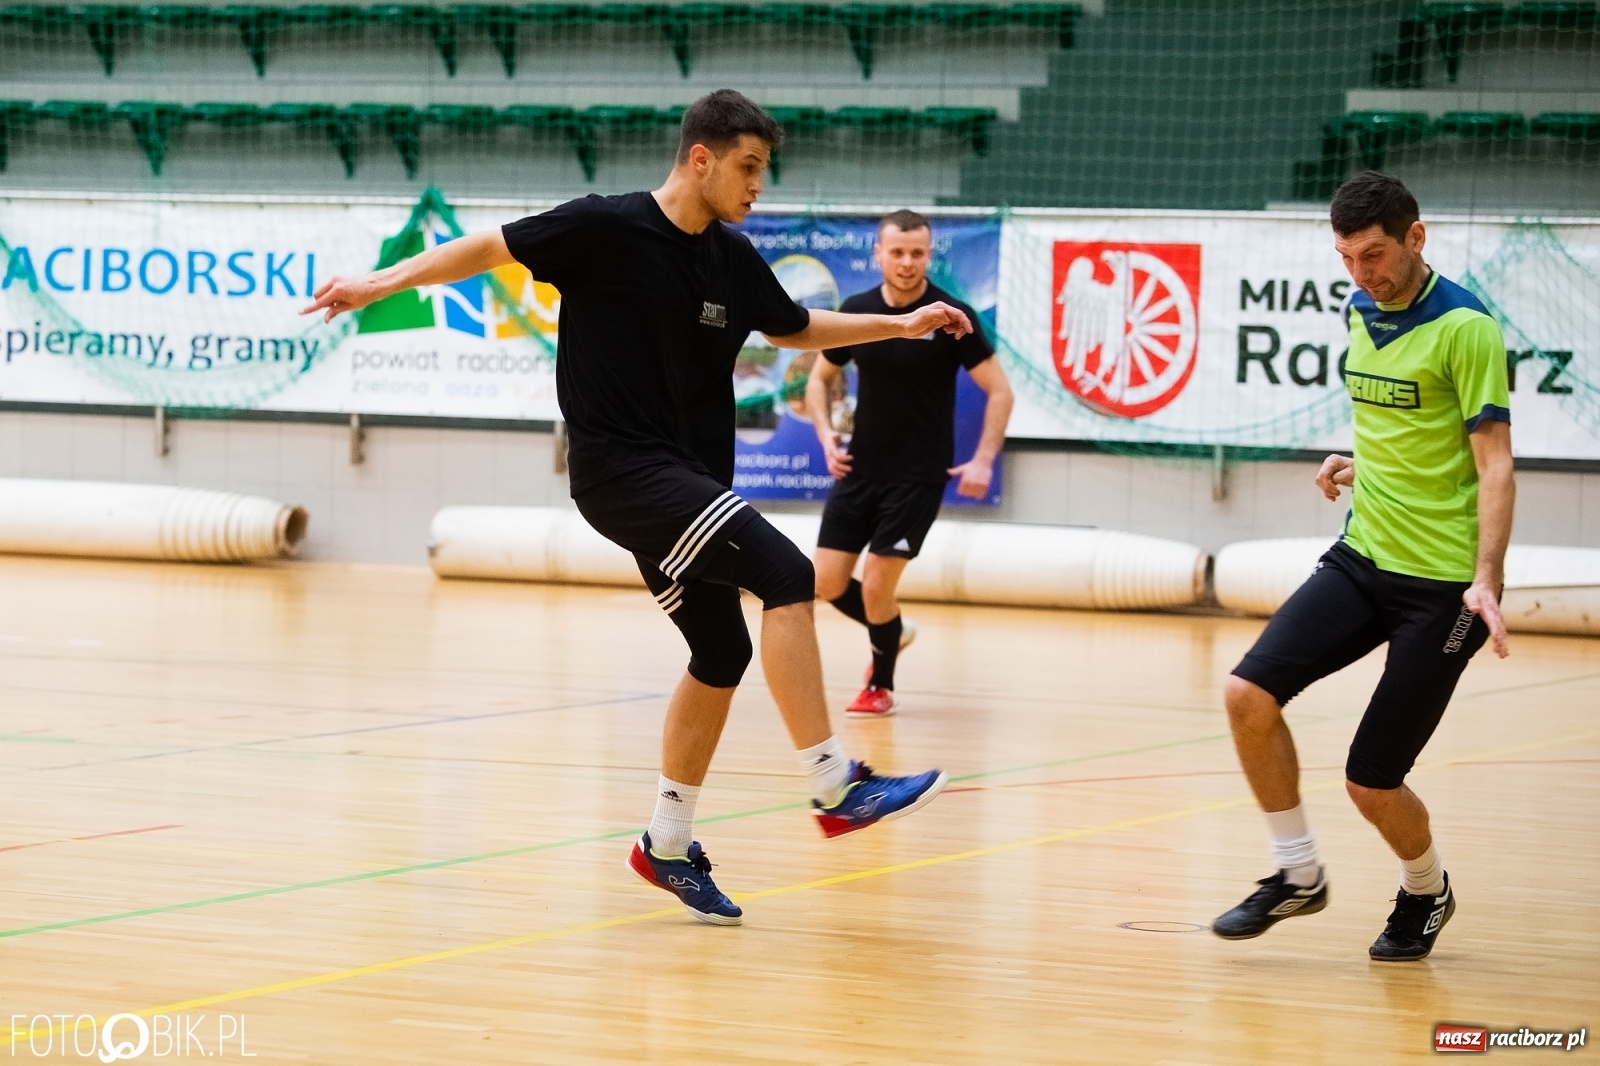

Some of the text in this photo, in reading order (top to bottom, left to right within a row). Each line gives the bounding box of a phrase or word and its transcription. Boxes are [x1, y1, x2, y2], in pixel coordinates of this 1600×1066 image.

[2, 246, 315, 297] ACIBORSKI
[0, 321, 319, 372] pieramy, gramy
[351, 346, 440, 373] powiat
[1345, 375, 1417, 405] RUKS
